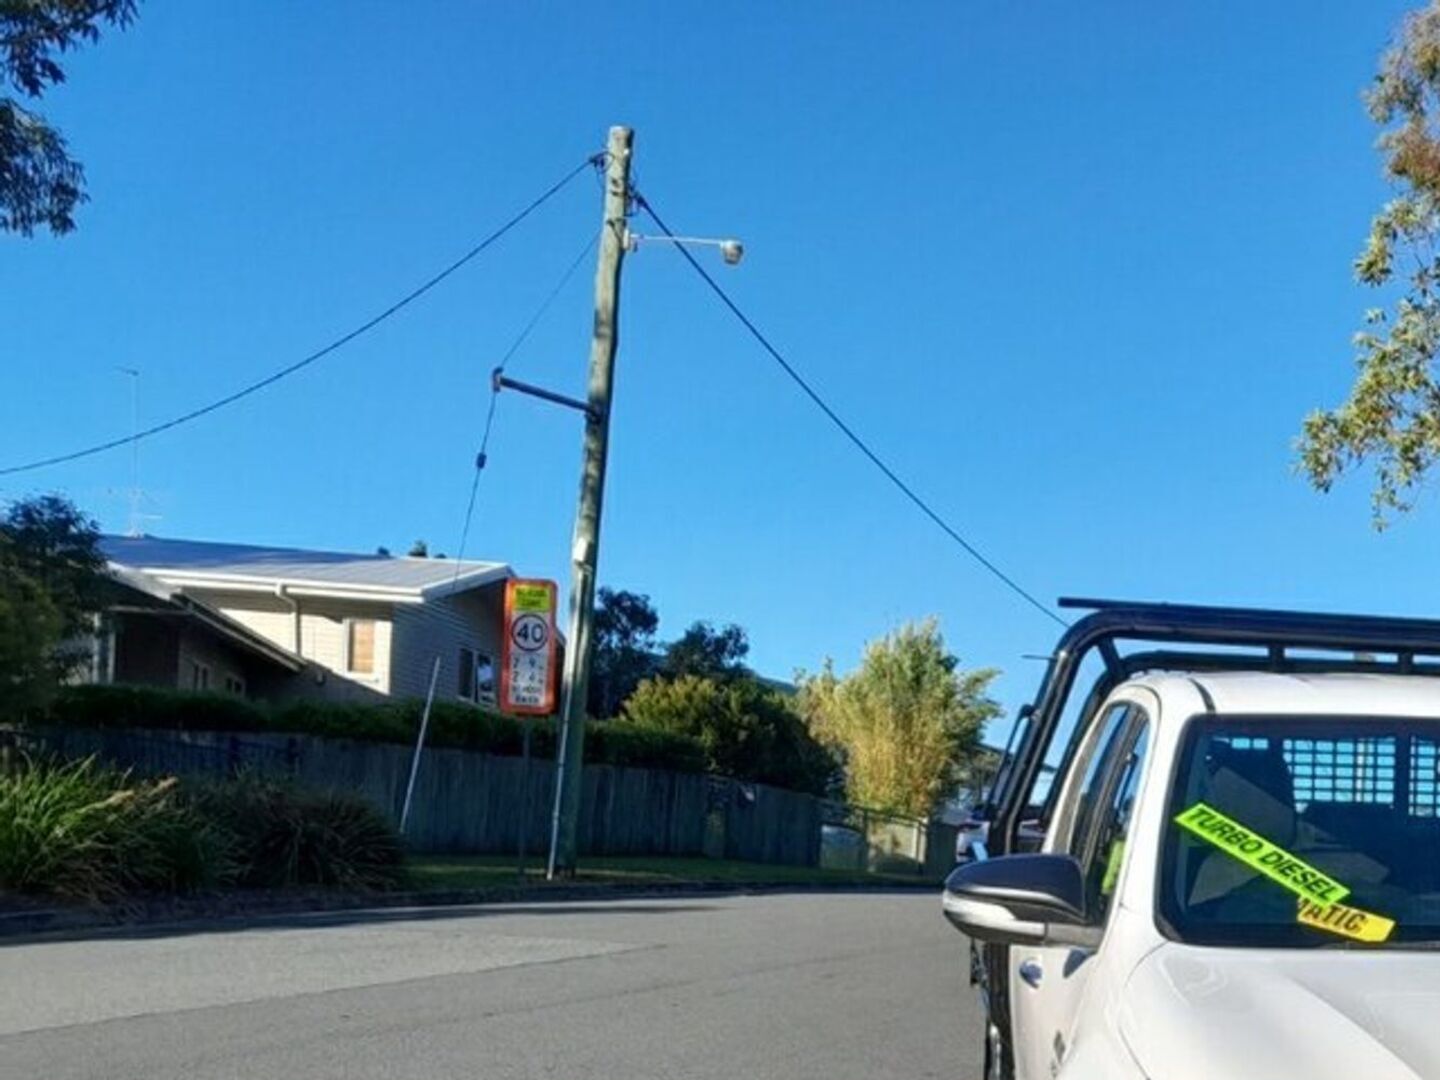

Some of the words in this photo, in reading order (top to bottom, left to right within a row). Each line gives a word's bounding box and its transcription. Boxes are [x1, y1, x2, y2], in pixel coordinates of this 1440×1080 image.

[517, 623, 544, 643] 40
[1188, 807, 1263, 859] TURBO
[1260, 848, 1341, 903] DIESEL
